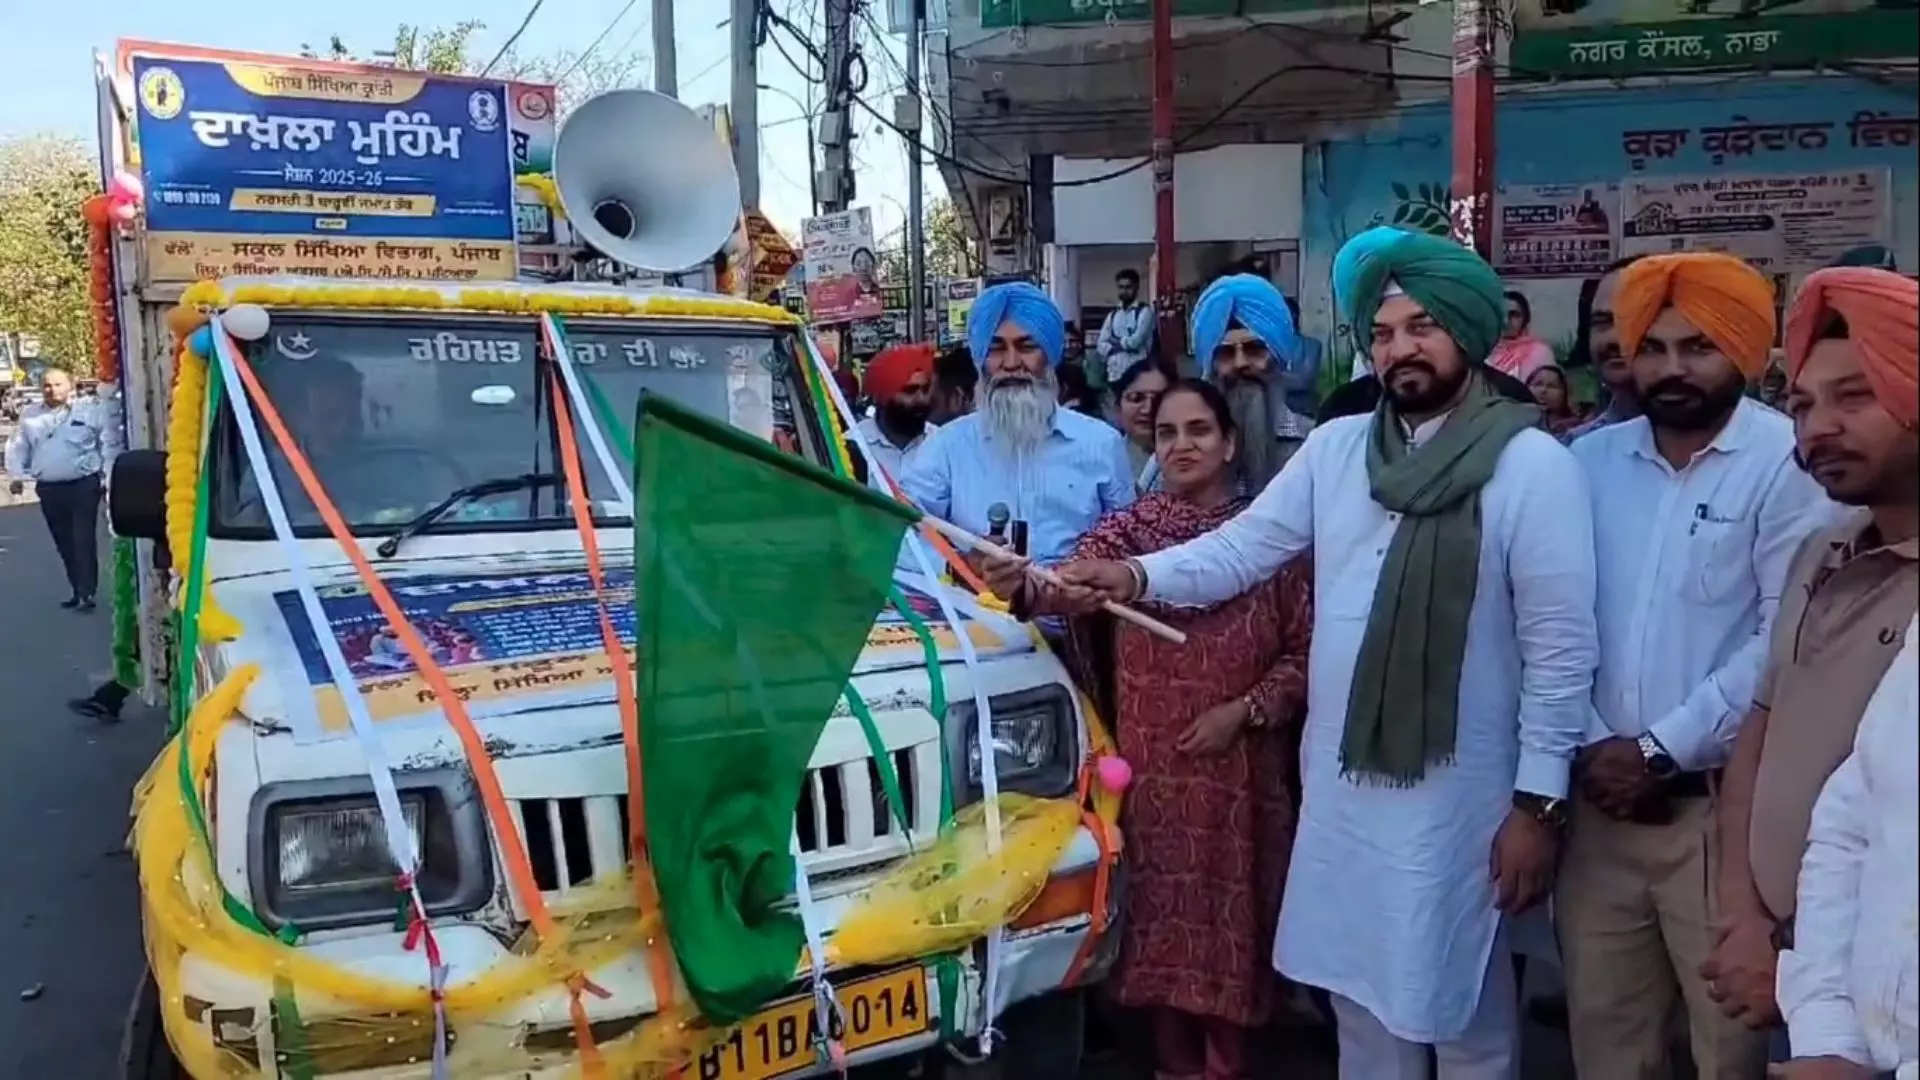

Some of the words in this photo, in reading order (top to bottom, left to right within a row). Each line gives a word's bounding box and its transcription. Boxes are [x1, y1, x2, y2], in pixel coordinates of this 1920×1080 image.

[1568, 40, 1628, 63] ਨਗਰ
[1725, 30, 1782, 54] ਨਾਭਾ
[348, 109, 462, 165] ਮੁਹਿੰਮ
[1622, 128, 1690, 170] ਕੂੜਾ
[1700, 114, 1834, 165] ਕੂੜੇਦਾਨ
[319, 168, 383, 186] 2025-26
[295, 240, 366, 258] ਸਿੱਖਿਆ
[452, 242, 502, 261] ਪੰਜਾਬ
[408, 332, 521, 362] ਰਹਿਮਤ
[621, 338, 657, 367] ਦੀ
